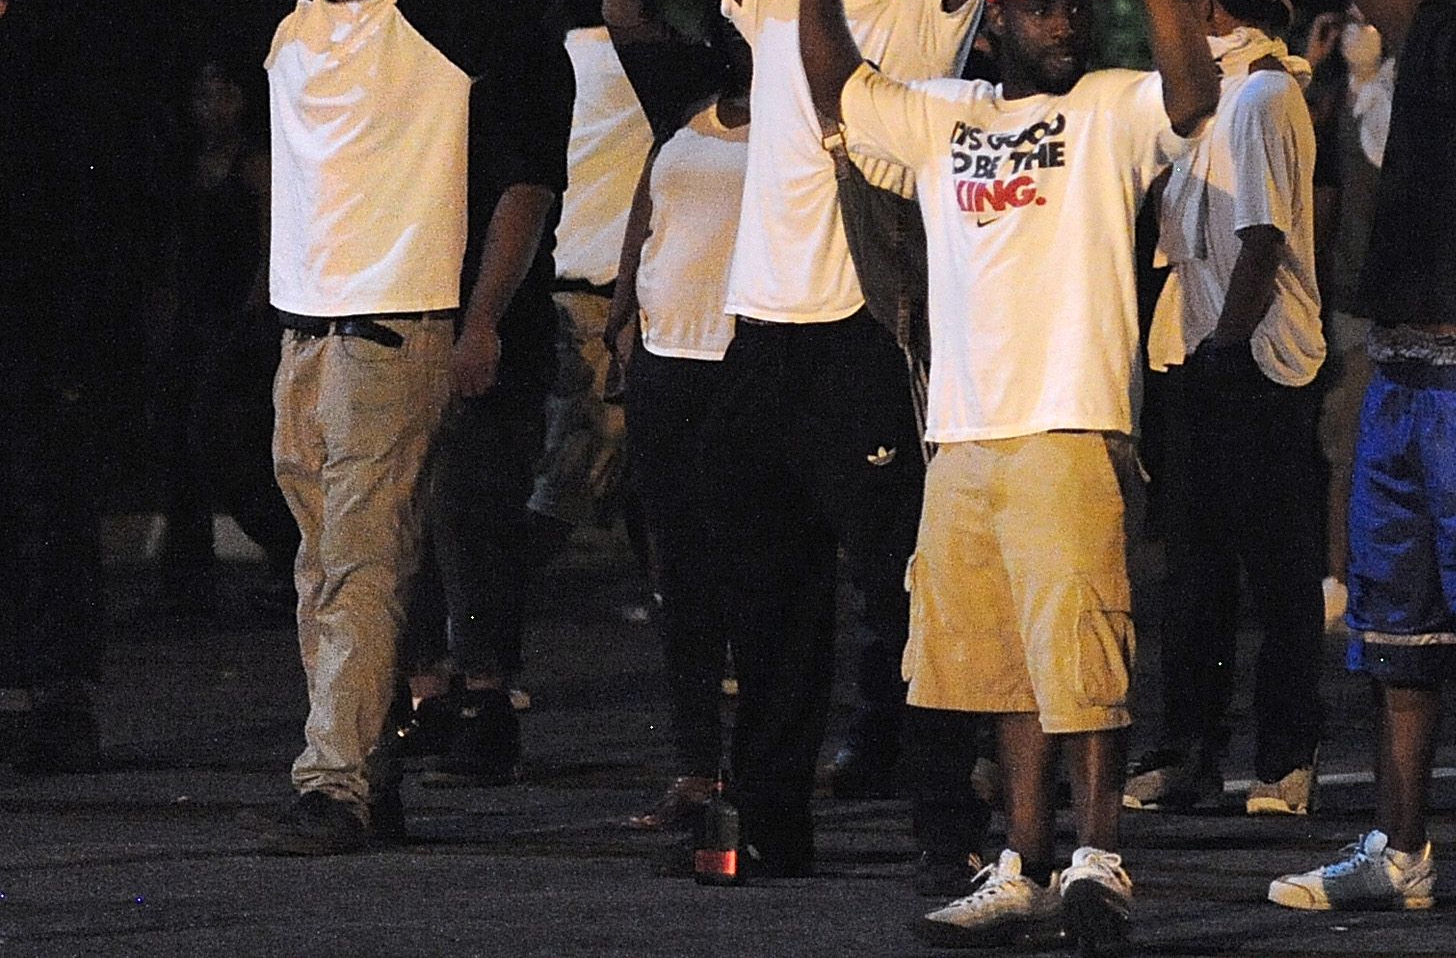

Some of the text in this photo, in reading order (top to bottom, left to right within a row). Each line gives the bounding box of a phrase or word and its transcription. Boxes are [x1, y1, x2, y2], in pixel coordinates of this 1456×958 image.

[951, 141, 1066, 179] O BE THE
